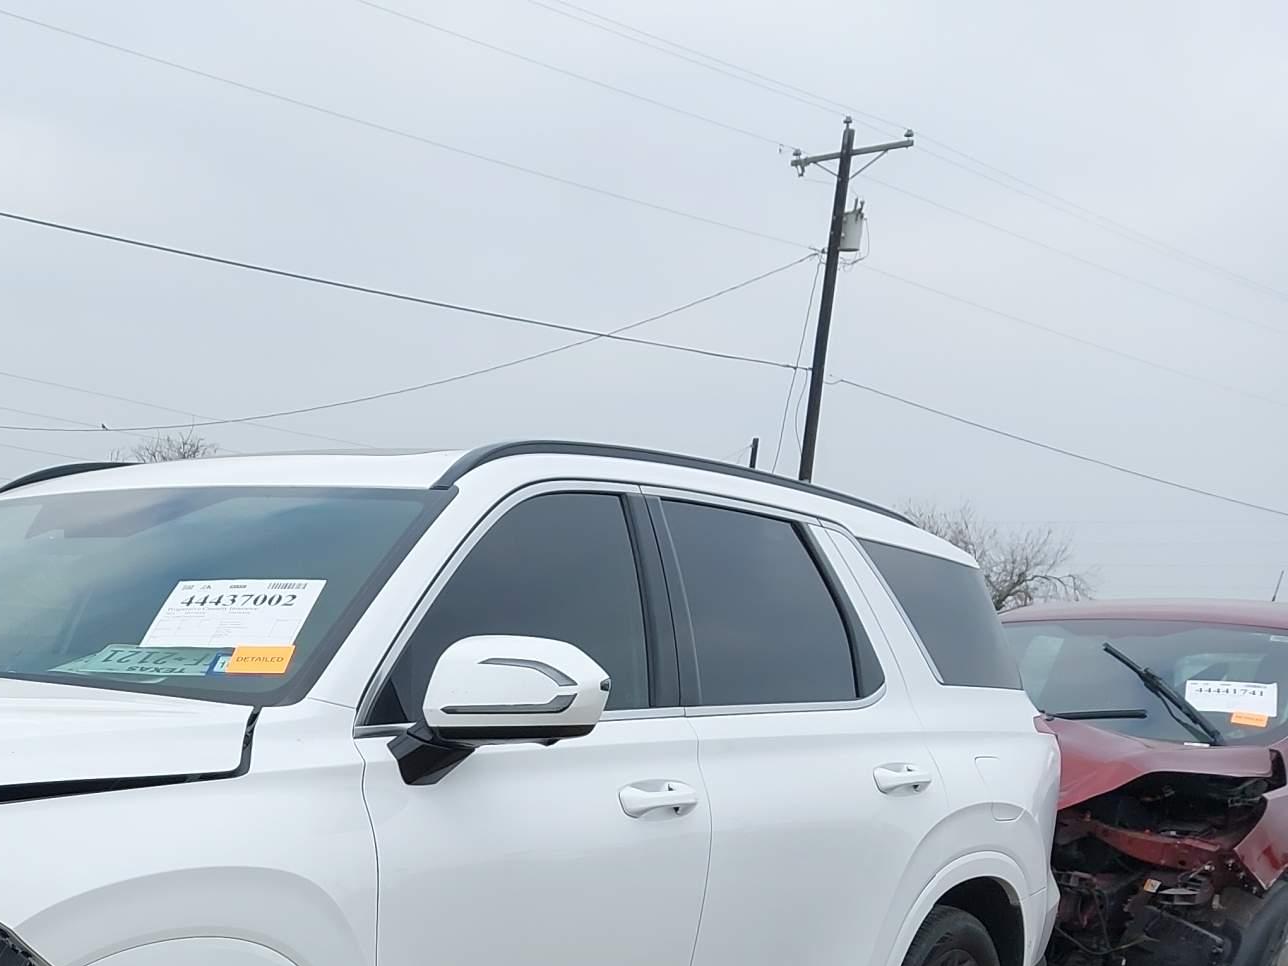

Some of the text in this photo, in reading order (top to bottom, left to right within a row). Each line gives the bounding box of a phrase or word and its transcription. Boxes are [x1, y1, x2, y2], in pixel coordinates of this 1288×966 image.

[180, 594, 297, 607] 44437002
[235, 655, 284, 663] DETAILED
[125, 665, 186, 674] TEXAS
